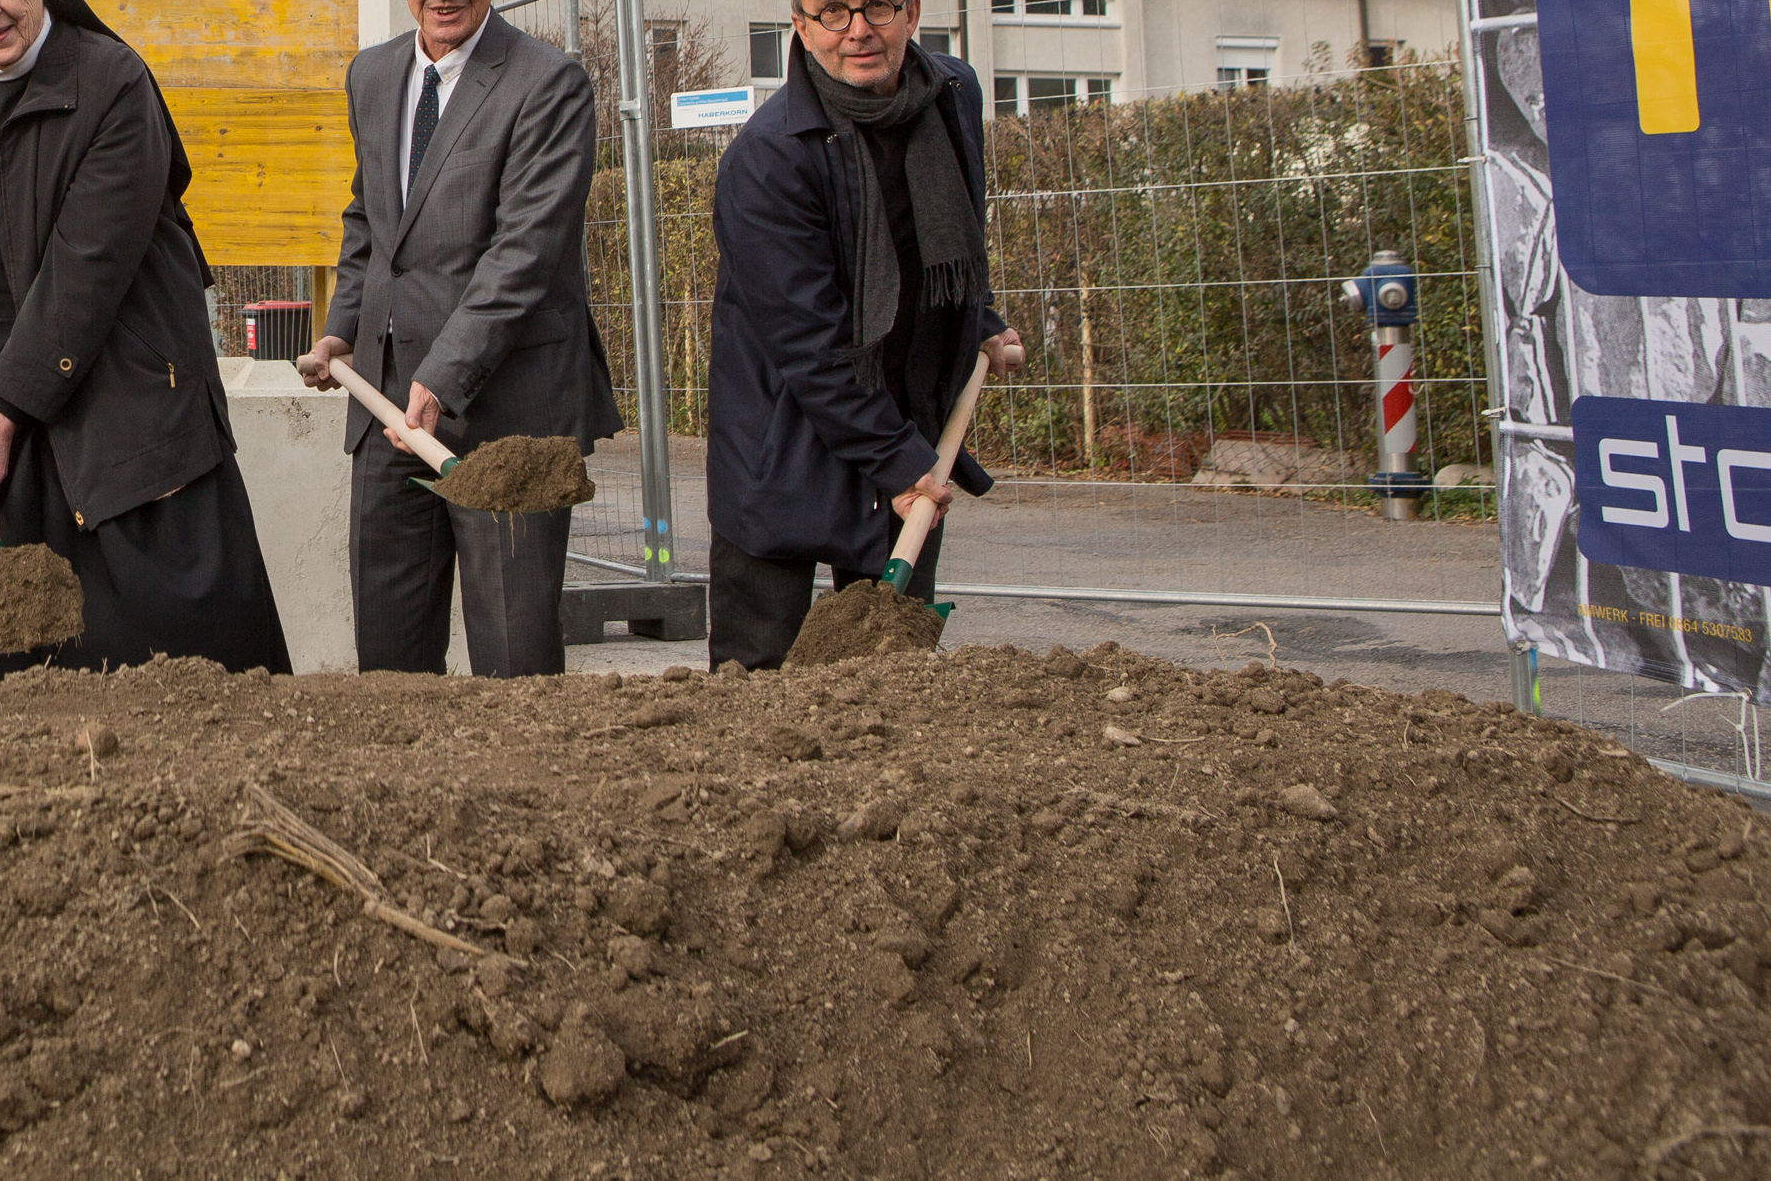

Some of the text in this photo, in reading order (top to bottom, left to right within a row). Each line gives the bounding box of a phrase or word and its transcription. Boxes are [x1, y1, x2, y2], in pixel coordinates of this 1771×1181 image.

[698, 109, 748, 118] HABERKORN
[1639, 612, 1665, 628] FREI
[1669, 617, 1698, 633] 0664
[1702, 621, 1753, 642] 5307583
